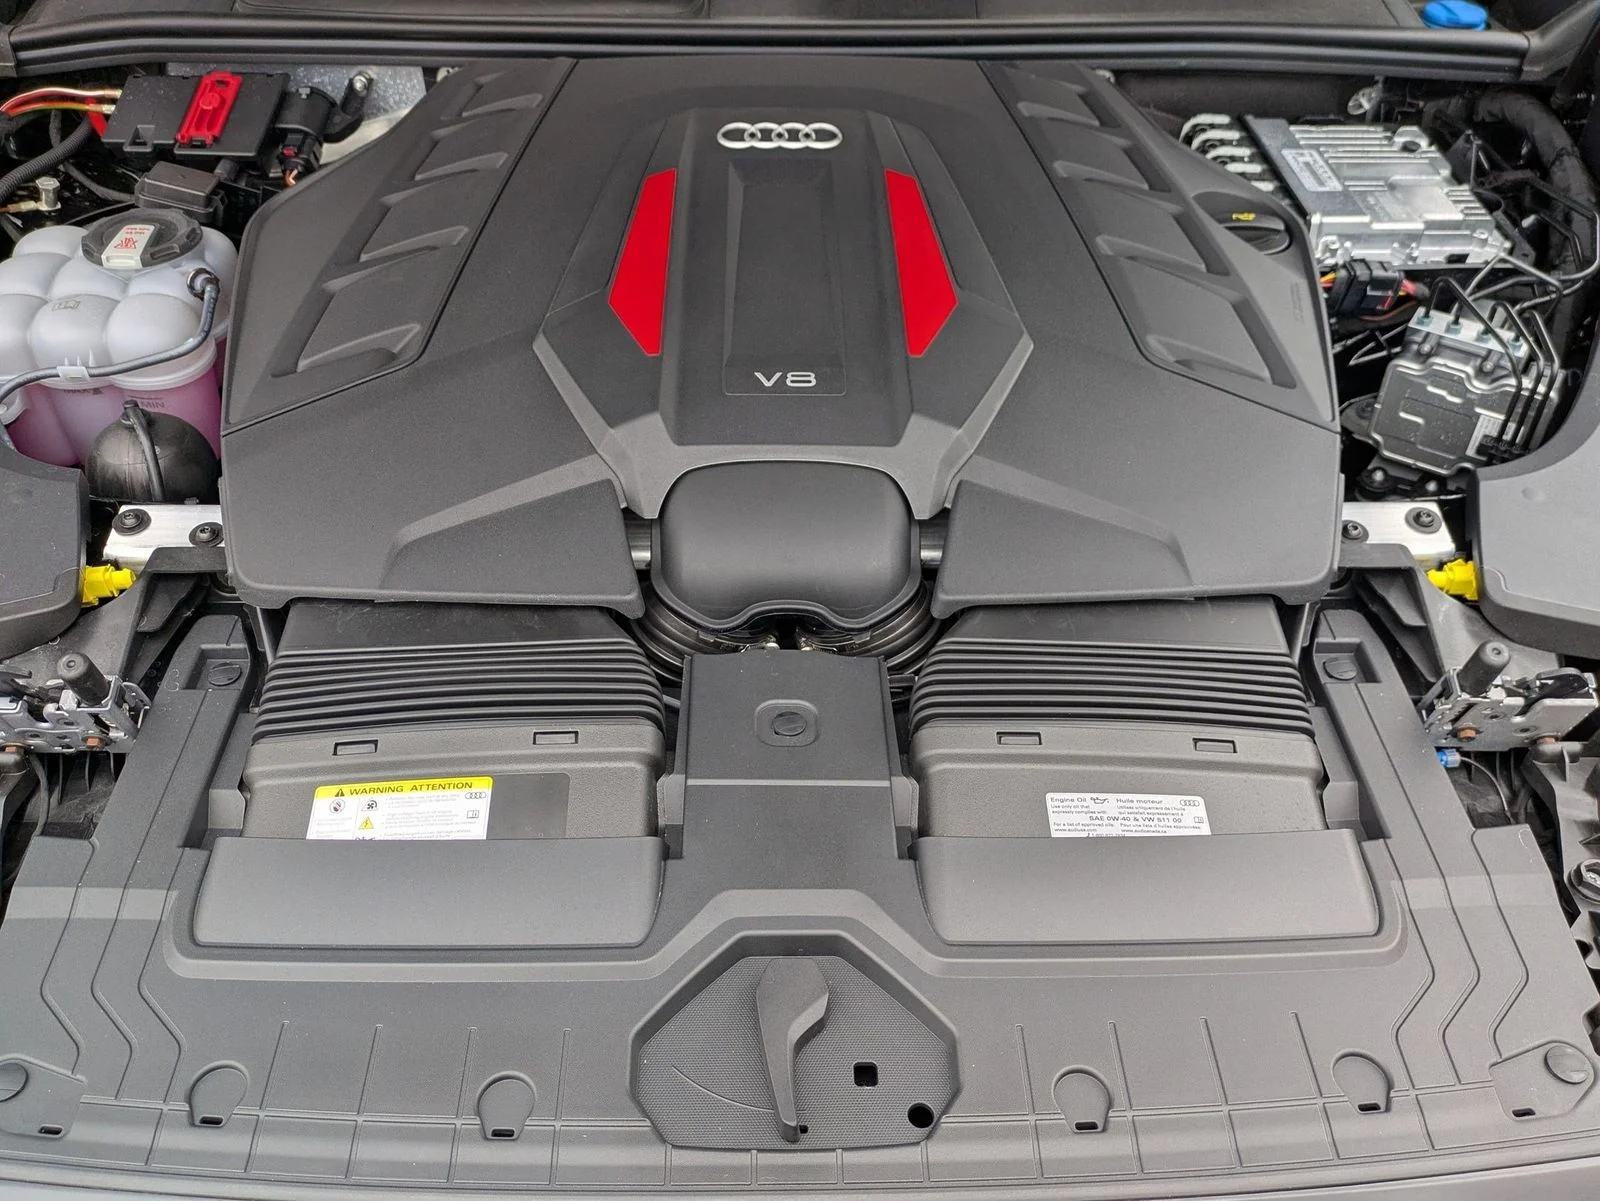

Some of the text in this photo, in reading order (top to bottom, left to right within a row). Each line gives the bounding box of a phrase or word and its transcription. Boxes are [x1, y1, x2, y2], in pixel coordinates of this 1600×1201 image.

[754, 372, 817, 387] V8
[350, 782, 473, 796] WARNING ATTENTION
